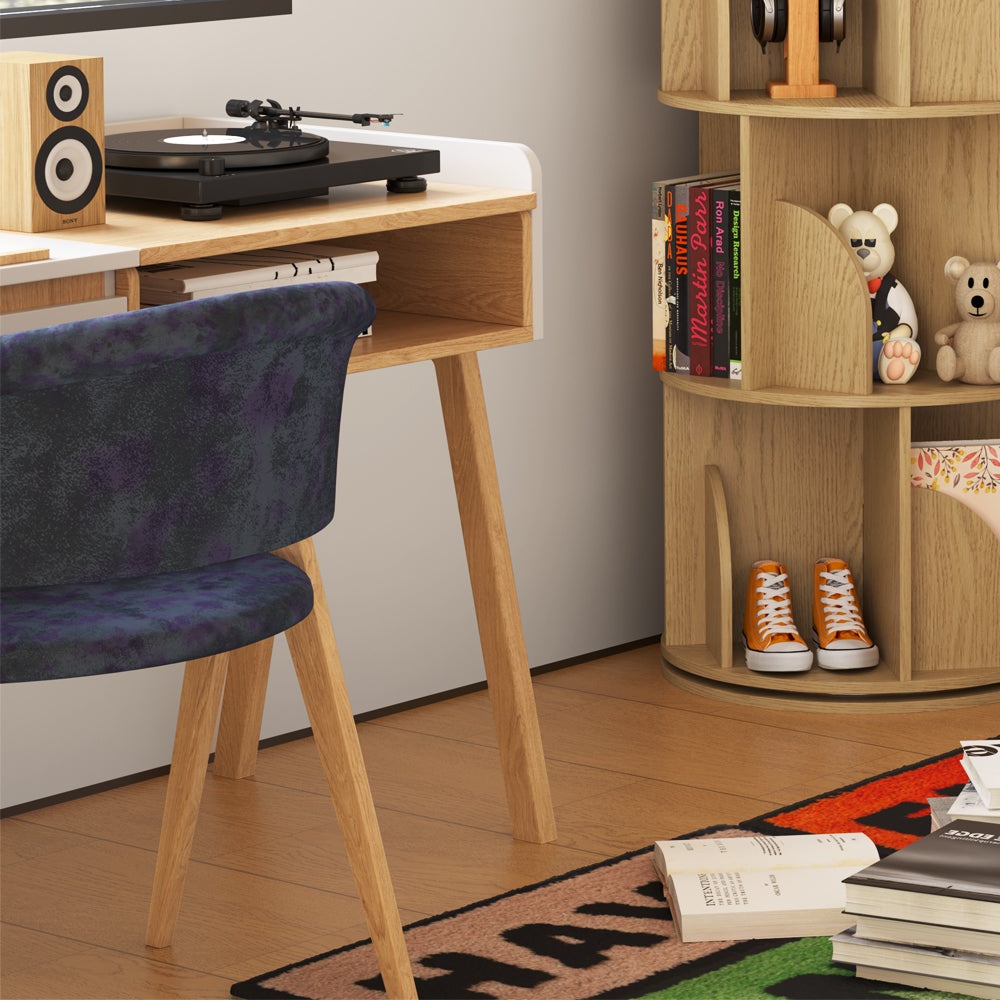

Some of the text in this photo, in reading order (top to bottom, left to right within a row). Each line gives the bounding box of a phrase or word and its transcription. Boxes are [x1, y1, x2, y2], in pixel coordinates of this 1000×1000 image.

[690, 191, 707, 251] Parr
[715, 200, 724, 223] Ron
[732, 210, 740, 240] Design
[675, 204, 688, 275] BAUHAUS
[715, 226, 725, 254] Arad
[715, 261, 725, 278] No
[732, 241, 740, 280] Research
[690, 257, 708, 347] Martin
